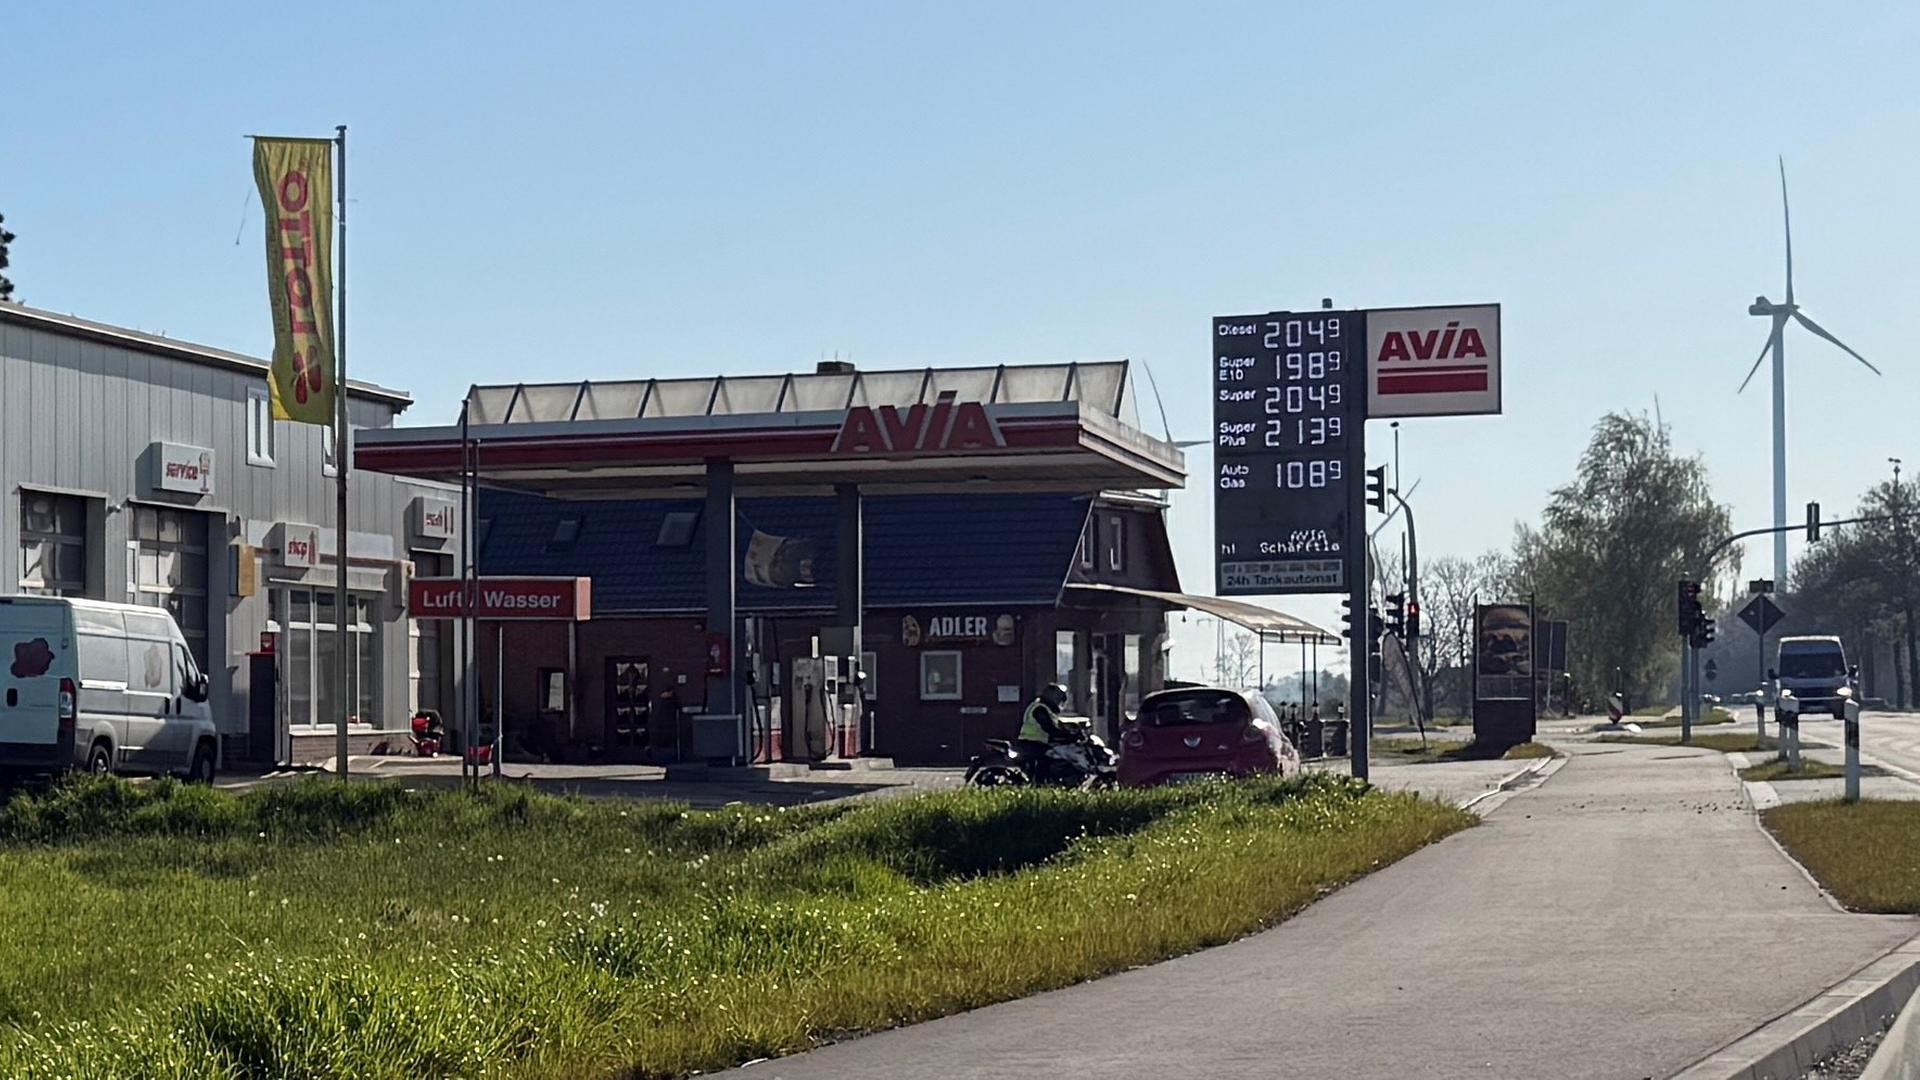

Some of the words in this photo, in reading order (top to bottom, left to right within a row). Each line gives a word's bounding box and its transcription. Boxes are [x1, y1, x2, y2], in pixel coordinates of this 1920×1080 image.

[1218, 324, 1256, 336] Diesel
[1219, 357, 1256, 368] Super
[1219, 370, 1244, 381] E10
[1219, 390, 1256, 402] Super
[1219, 422, 1256, 434] Super
[1219, 436, 1246, 447] Plus
[1221, 464, 1249, 475] Auto
[1220, 477, 1246, 488] Gas
[1227, 574, 1250, 586] 24h
[1255, 573, 1337, 585] Tankautomat
[422, 590, 463, 608] Luft
[483, 590, 561, 608] Wasser
[929, 616, 987, 637] ADLER
